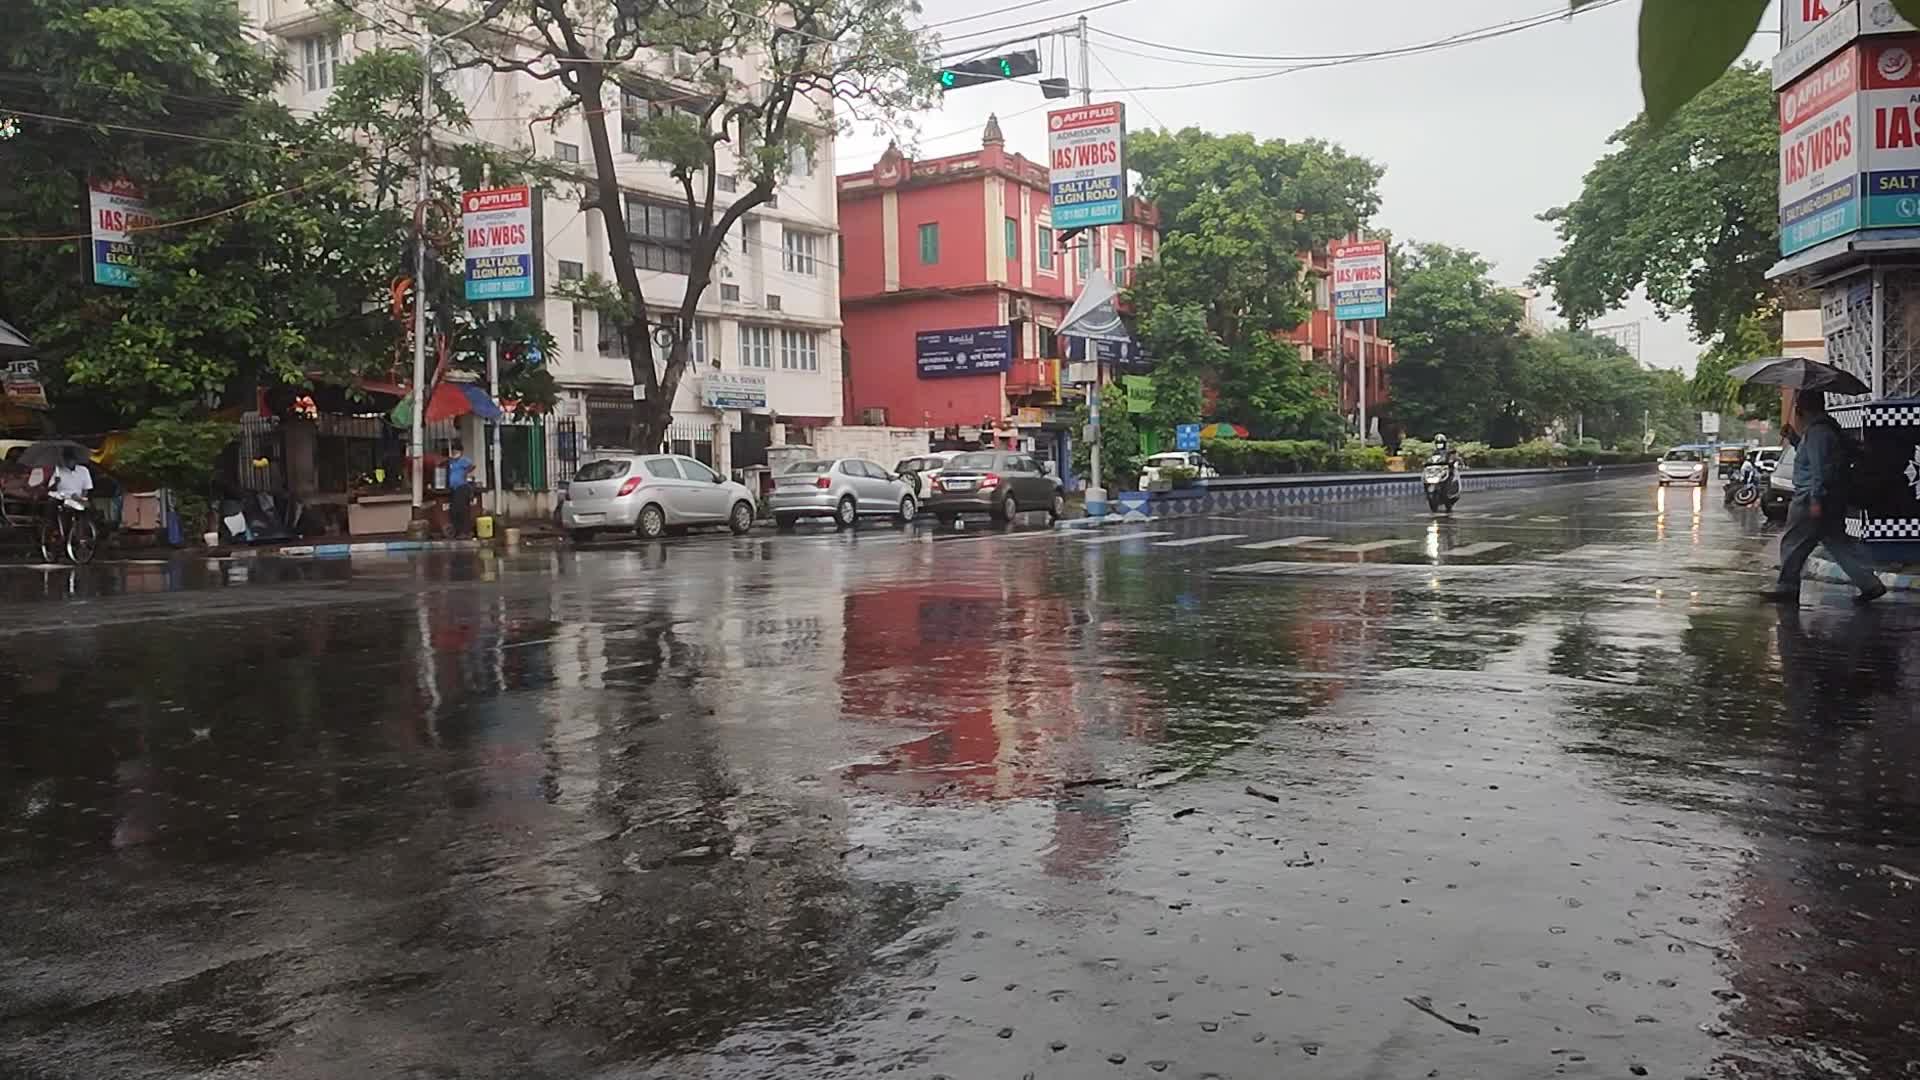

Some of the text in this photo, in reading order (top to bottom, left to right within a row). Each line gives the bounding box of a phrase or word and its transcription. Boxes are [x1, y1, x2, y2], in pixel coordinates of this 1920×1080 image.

[1798, 57, 1850, 107] APTI PLUS
[1064, 106, 1114, 122] APTI PLUS
[1057, 126, 1111, 140] ADMISSIONS
[1052, 141, 1116, 169] IAS/WBCS
[1784, 114, 1852, 185] IAS/WBCS
[1058, 178, 1113, 194] SALT LAKE
[1880, 175, 1918, 190] SALT
[480, 192, 522, 205] APTI PLUS
[1054, 188, 1118, 205] ELGIN ROAD
[468, 224, 525, 249] IAS/WBCS
[476, 256, 519, 268] SALT LAKE
[472, 266, 523, 280] ELGIN ROAD
[1336, 266, 1382, 283] IAS/WBCS
